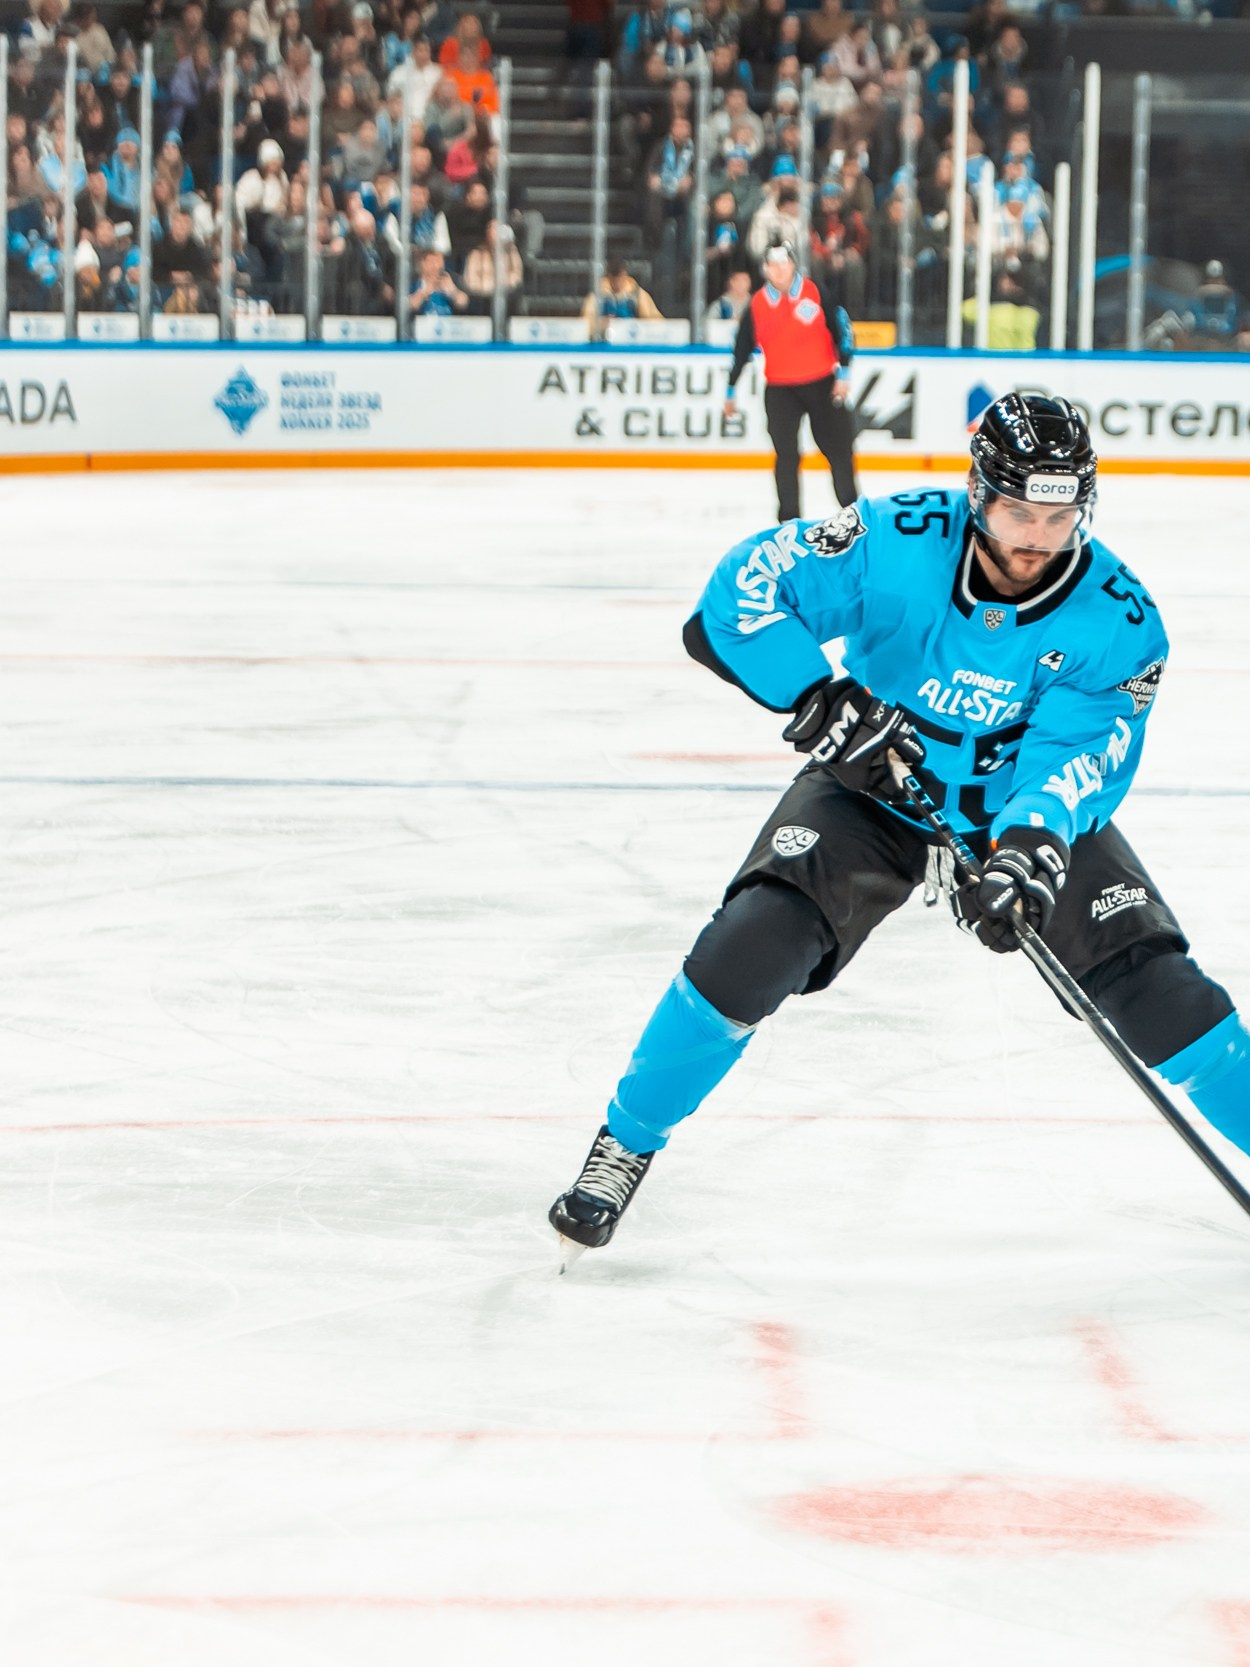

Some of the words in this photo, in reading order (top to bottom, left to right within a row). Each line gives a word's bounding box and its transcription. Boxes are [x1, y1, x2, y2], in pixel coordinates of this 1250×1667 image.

[538, 364, 757, 396] ATRIBUI
[574, 408, 603, 437] &
[623, 408, 748, 439] CLUB
[1030, 482, 1076, 495] согаз
[890, 491, 949, 538] 55
[951, 669, 1018, 695] FONBET
[810, 700, 860, 762] CM
[905, 775, 948, 827] OTO
